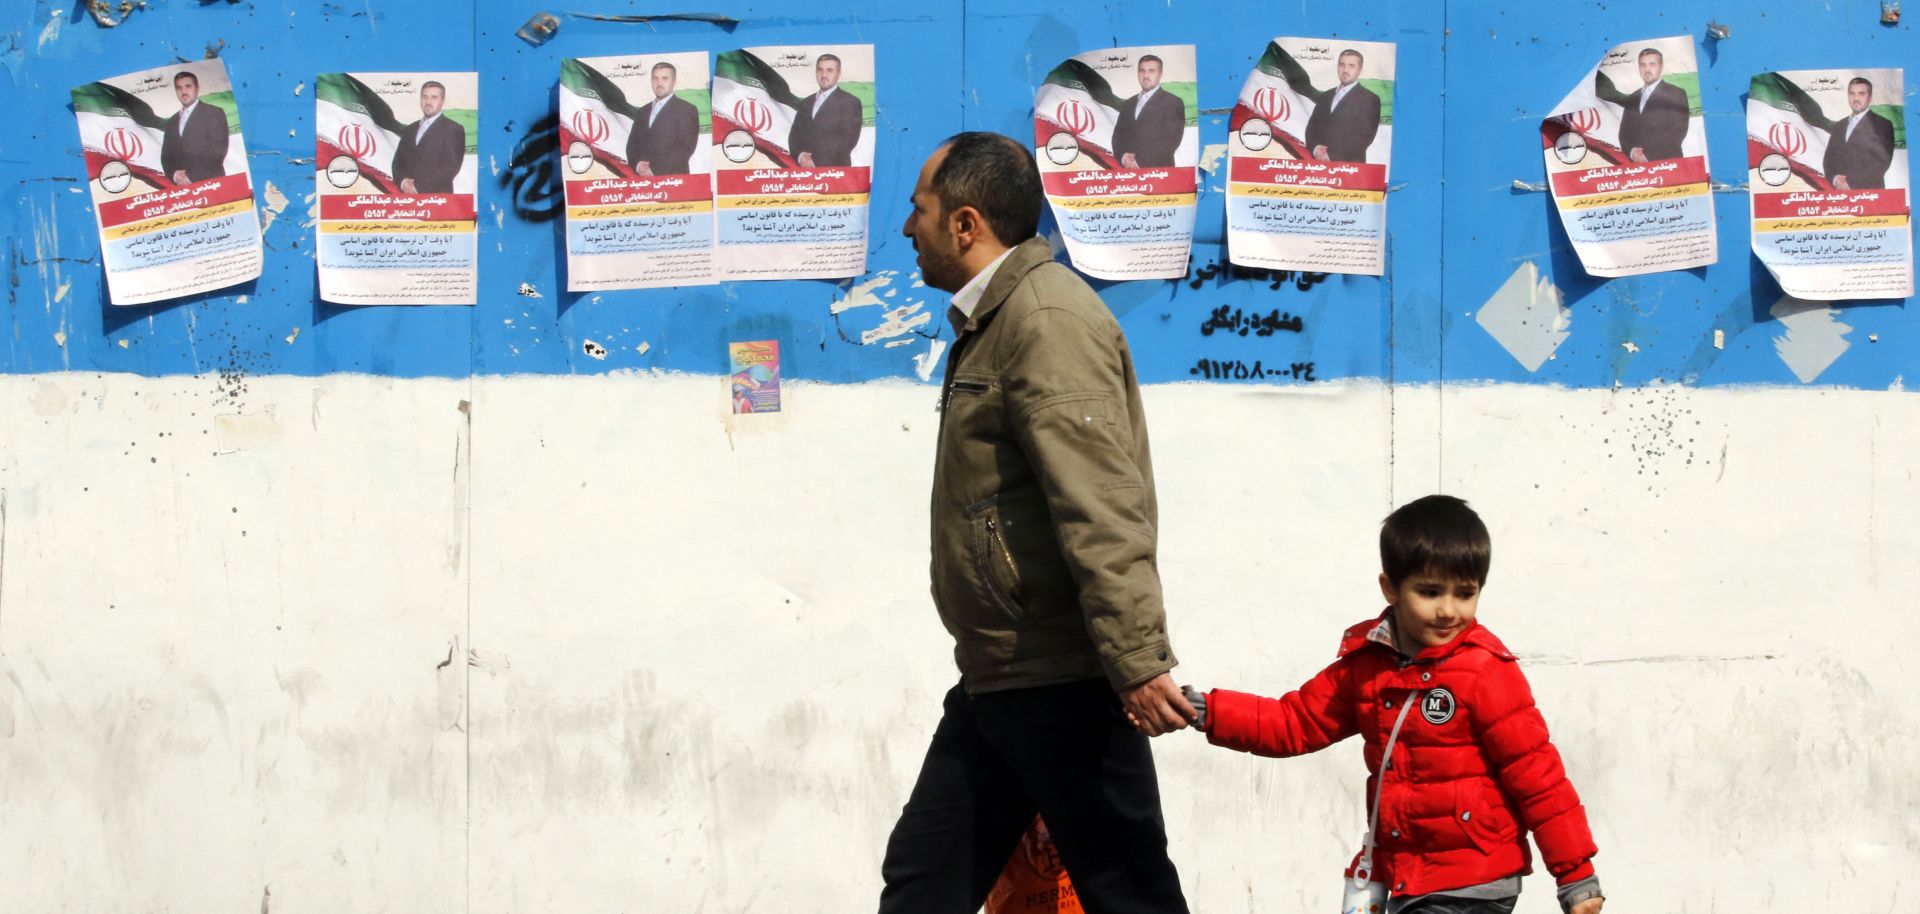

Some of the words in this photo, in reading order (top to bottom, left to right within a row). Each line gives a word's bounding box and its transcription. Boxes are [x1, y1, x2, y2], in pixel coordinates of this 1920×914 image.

[1259, 159, 1303, 172] عبدالملکی
[1305, 163, 1327, 173] حمید
[1328, 165, 1359, 175] مهندس
[1648, 162, 1678, 174] مهندس
[745, 169, 789, 182] عبدالملکی
[790, 171, 813, 180] حمید
[814, 169, 845, 180] مهندس
[1138, 170, 1169, 181] مهندس
[1579, 167, 1623, 182] عبدالملکی
[1624, 166, 1646, 176] حمید
[1069, 171, 1113, 184] عبدالملکی
[1114, 172, 1137, 181] حمید
[1298, 176, 1327, 185] انتخاباتی
[584, 179, 628, 193] عبدالملکی
[629, 180, 651, 190] حمید
[653, 177, 683, 189] مهندس
[785, 183, 814, 193] انتخاباتی
[1621, 178, 1649, 190] انتخاباتی
[169, 188, 190, 199] حمید
[192, 182, 221, 196] مهندس
[1110, 184, 1138, 194] انتخاباتی
[126, 192, 168, 210] عبدالملکی
[348, 195, 391, 207] عبدالملکی
[393, 197, 415, 206] حمید
[417, 196, 447, 207] مهندس
[625, 192, 653, 203] انتخاباتی
[1781, 192, 1824, 205] عبدالملکی
[1826, 193, 1848, 203] حمید
[1849, 192, 1879, 203] مهندس
[167, 200, 194, 214] انتخاباتی
[1249, 201, 1270, 209] اساسی
[1271, 202, 1288, 210] قانون
[1327, 203, 1337, 213] آن
[1654, 202, 1663, 212] آن
[1679, 199, 1688, 207] آیا
[387, 209, 416, 219] انتخاباتی
[816, 209, 826, 219] آن
[842, 208, 851, 216] آیا
[1305, 205, 1326, 213] نرسیده
[1339, 206, 1352, 214] وقت
[1354, 205, 1363, 213] آیا
[1598, 209, 1614, 219] قانون
[1821, 206, 1849, 216] انتخاباتی
[738, 212, 758, 221] اساسی
[759, 211, 776, 220] قانون
[1288, 215, 1305, 224] ایران
[1306, 216, 1329, 224] اسلامی
[1577, 211, 1596, 222] اساسی
[1658, 215, 1684, 224] جمهوری
[225, 217, 234, 226] آیا
[1602, 220, 1615, 229] آشنا
[1617, 219, 1634, 229] ایران
[1635, 216, 1657, 227] اسلامی
[179, 228, 200, 236] نرسیده
[201, 222, 209, 233] آن
[778, 223, 795, 232] ایران
[796, 223, 818, 232] اسلامی
[206, 233, 231, 245] جمهوری
[444, 235, 453, 243] آیا
[1796, 234, 1813, 243] قانون
[1852, 231, 1861, 241] آن
[1863, 232, 1877, 240] وقت
[1878, 230, 1886, 238] آیا
[126, 237, 145, 249] اساسی
[147, 234, 163, 245] قانون
[183, 237, 204, 249] اسلامی
[340, 237, 360, 246] اساسی
[361, 237, 378, 246] قانون
[418, 236, 427, 245] آن
[429, 237, 443, 245] وقت
[1775, 235, 1795, 244] اساسی
[151, 245, 163, 254] آشنا
[166, 242, 182, 253] ایران
[365, 248, 377, 256] آشنا
[1800, 245, 1813, 253] آشنا
[1815, 246, 1832, 255] ایران
[1833, 245, 1854, 254] اسلامی
[1856, 245, 1881, 253] جمهوری
[379, 249, 396, 258] ایران
[397, 249, 419, 258] اسلامی
[421, 250, 447, 258] جمهوری
